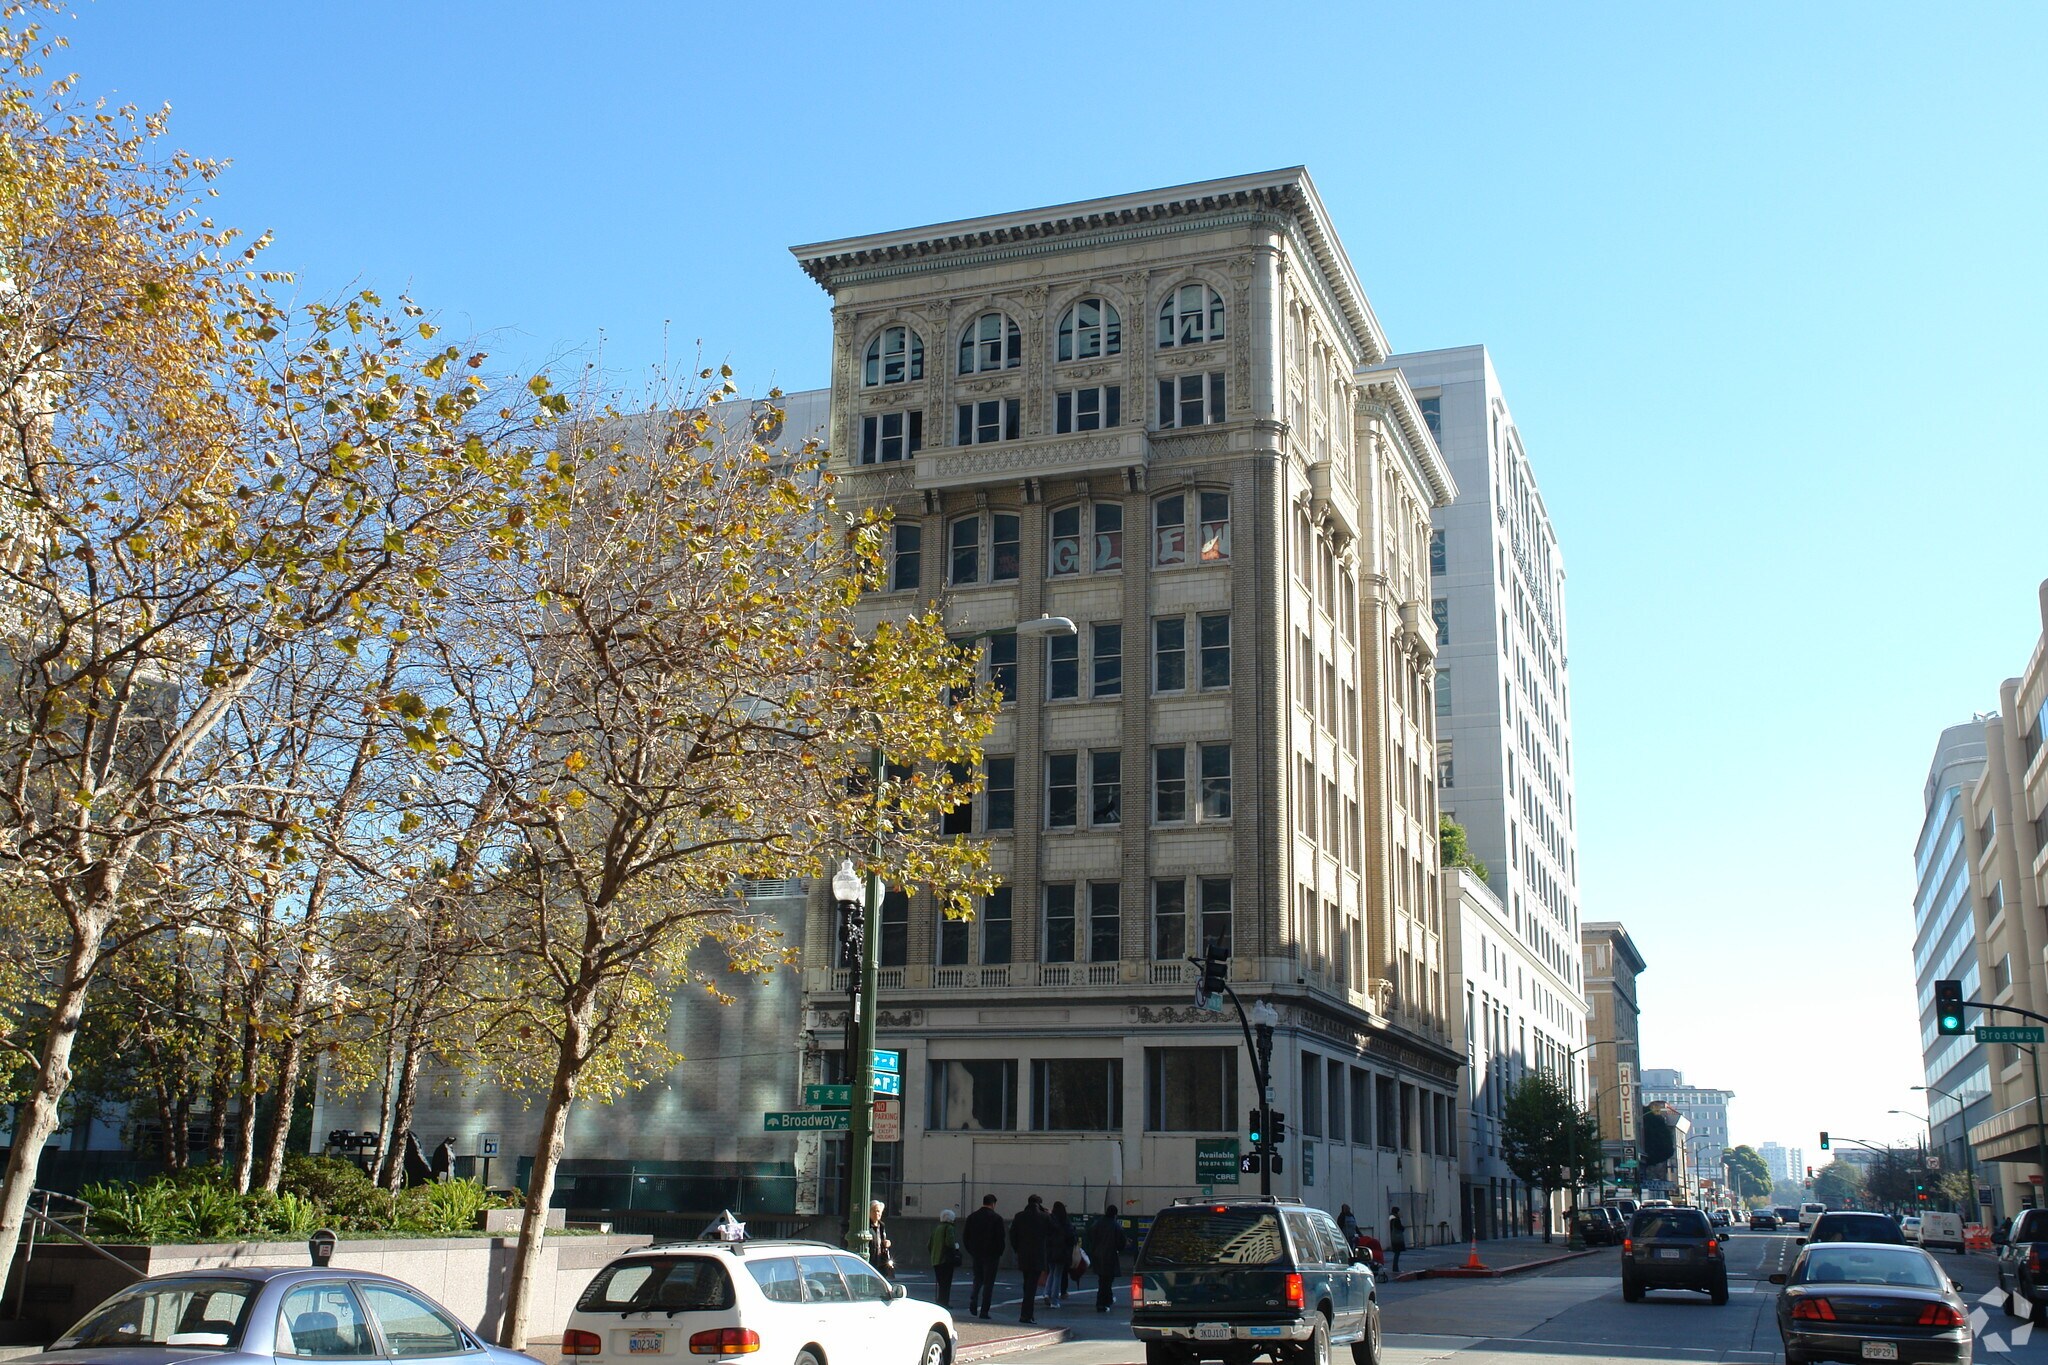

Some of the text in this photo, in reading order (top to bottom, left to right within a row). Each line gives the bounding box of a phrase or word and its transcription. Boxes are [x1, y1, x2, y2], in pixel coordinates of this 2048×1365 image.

[1980, 1029, 2039, 1042] Broadway
[876, 1102, 885, 1112] NO
[1620, 1070, 1631, 1138] HOTEL
[782, 1114, 837, 1129] Broadway
[874, 1112, 897, 1120] PARKING
[1198, 1151, 1235, 1159] Available
